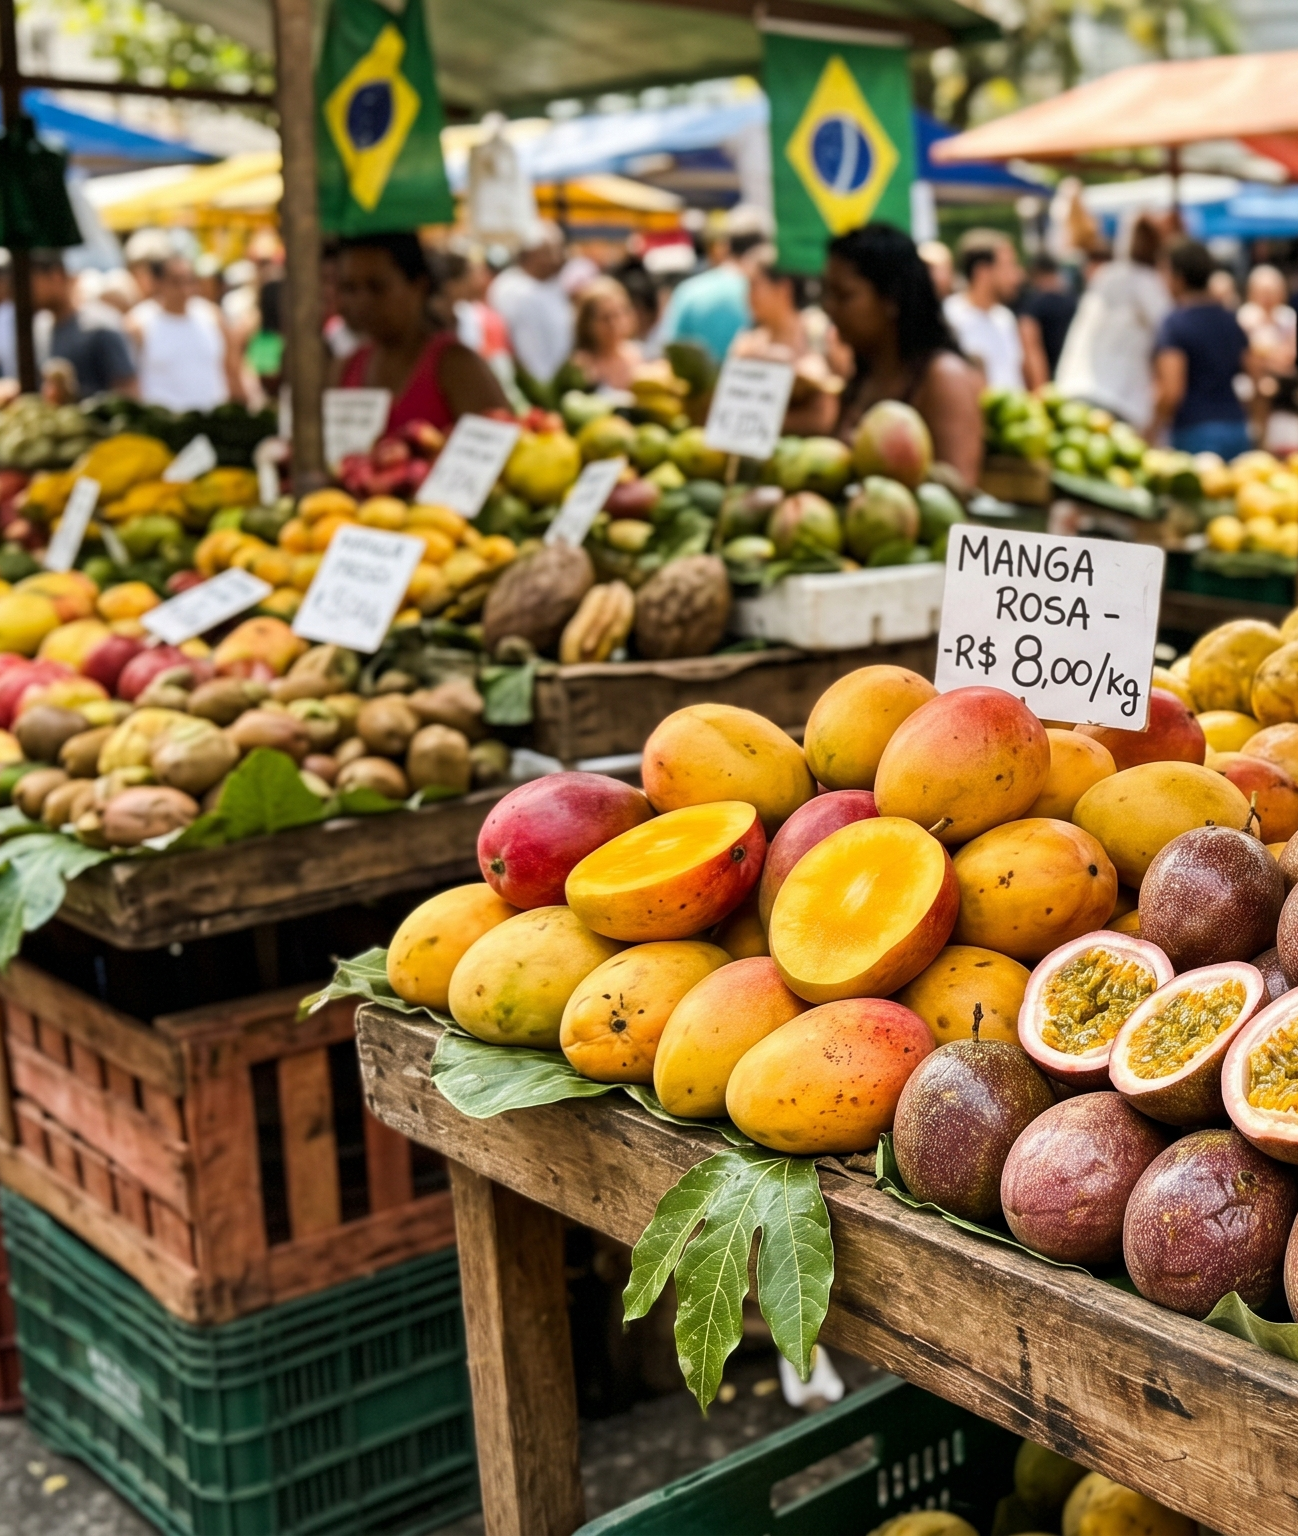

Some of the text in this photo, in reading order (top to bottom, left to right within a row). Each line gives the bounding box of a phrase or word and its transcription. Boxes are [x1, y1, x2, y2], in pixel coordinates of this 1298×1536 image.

[958, 534, 1094, 587] MANGA
[996, 586, 1090, 631] ROSA
[1011, 634, 1141, 717] 8,00/kg
